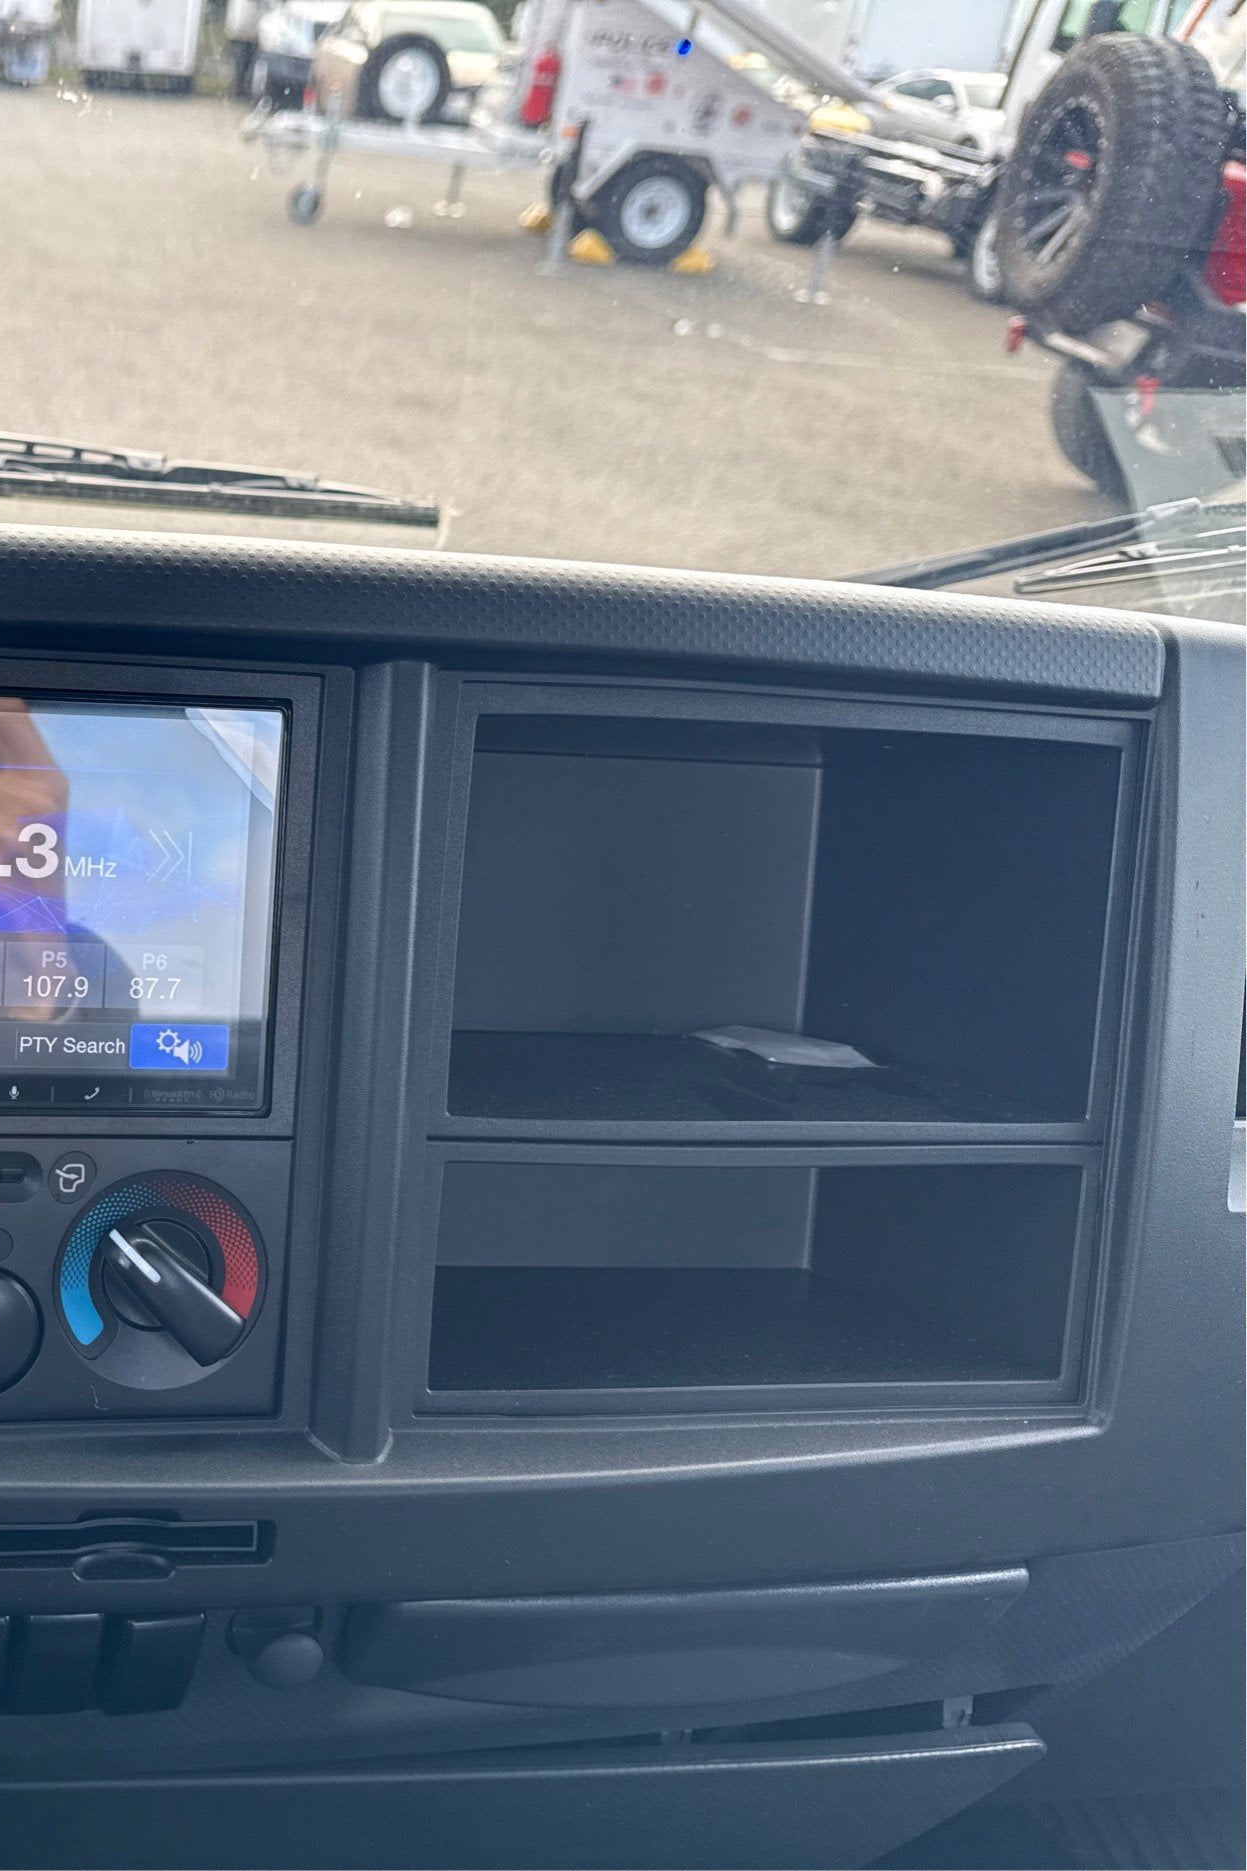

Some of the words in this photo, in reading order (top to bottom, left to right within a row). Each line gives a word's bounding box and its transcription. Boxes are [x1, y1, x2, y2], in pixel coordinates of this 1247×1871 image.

[64, 856, 117, 878] MHz
[41, 950, 67, 968] P5
[142, 952, 168, 971] P6
[22, 975, 89, 998] 107.9
[129, 977, 182, 1000] 87.7
[19, 1037, 58, 1054] PTY
[62, 1037, 126, 1055] Search
